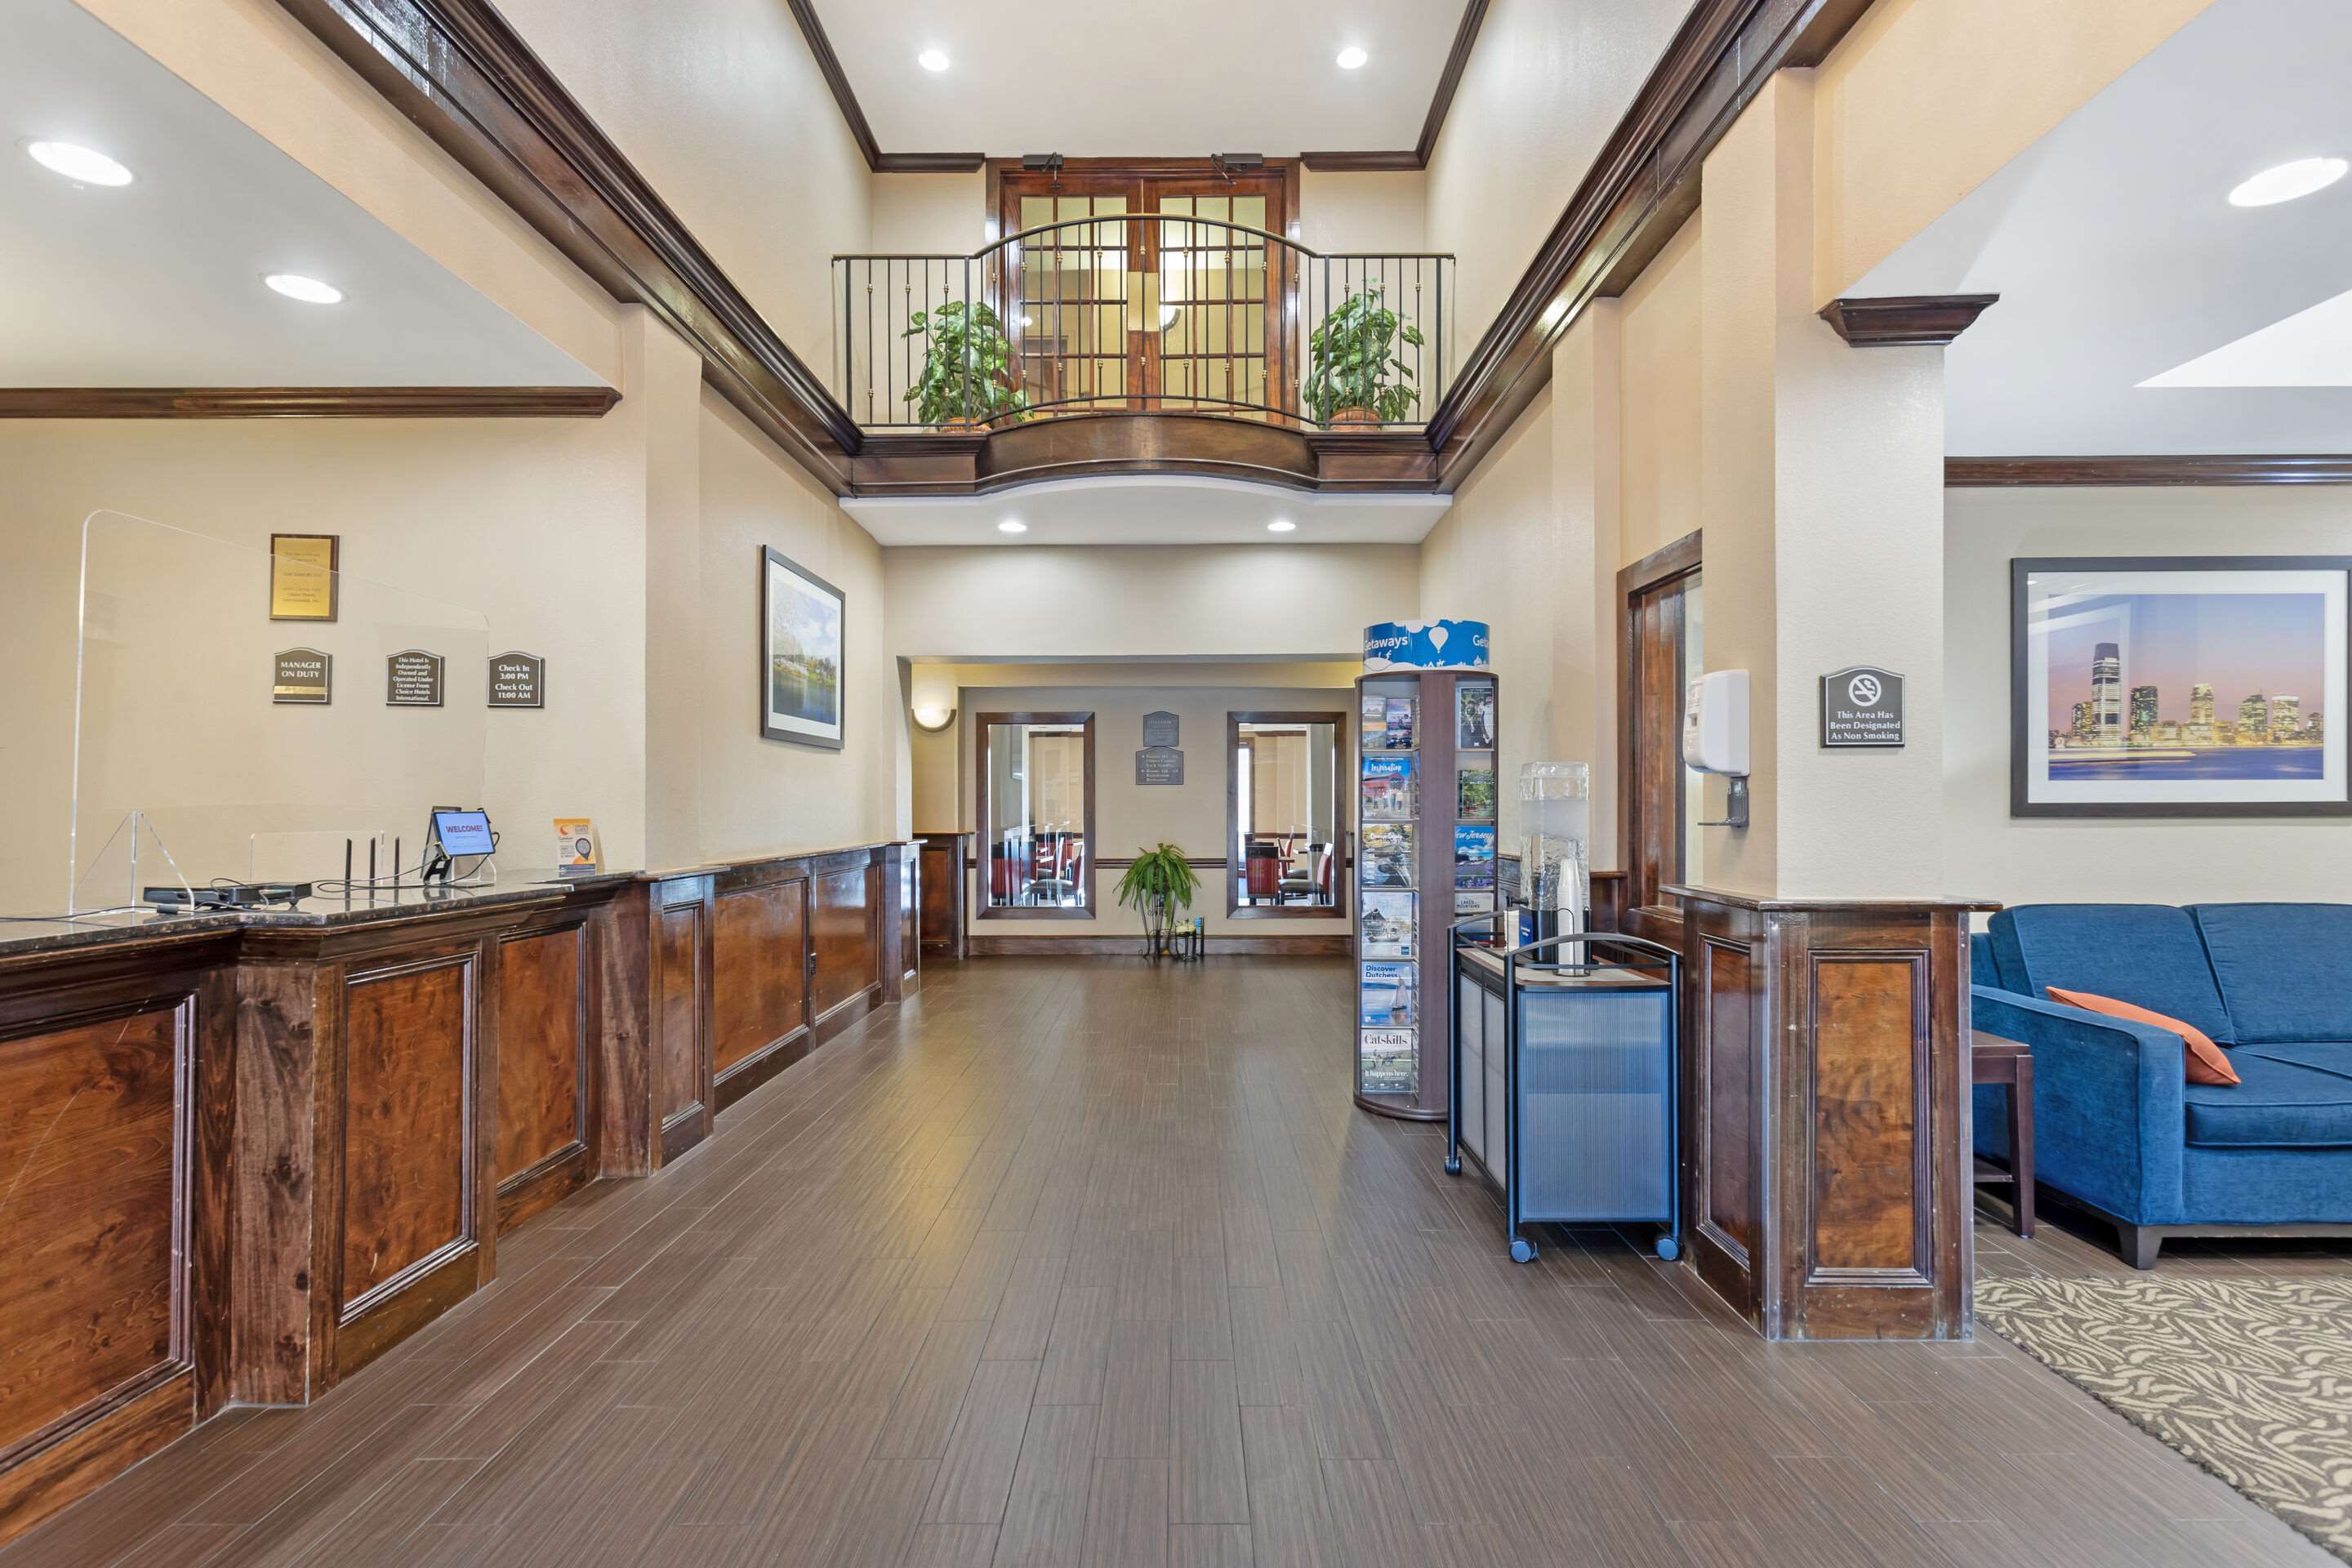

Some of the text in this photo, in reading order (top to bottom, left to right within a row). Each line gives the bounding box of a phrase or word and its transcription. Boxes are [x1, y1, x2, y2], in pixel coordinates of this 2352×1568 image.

[1853, 721, 1900, 730] Designated
[1863, 732, 1900, 741] Smoking
[1371, 764, 1402, 773] Inspiration
[1466, 830, 1493, 843] Jersey
[1365, 1034, 1408, 1045] Catskills
